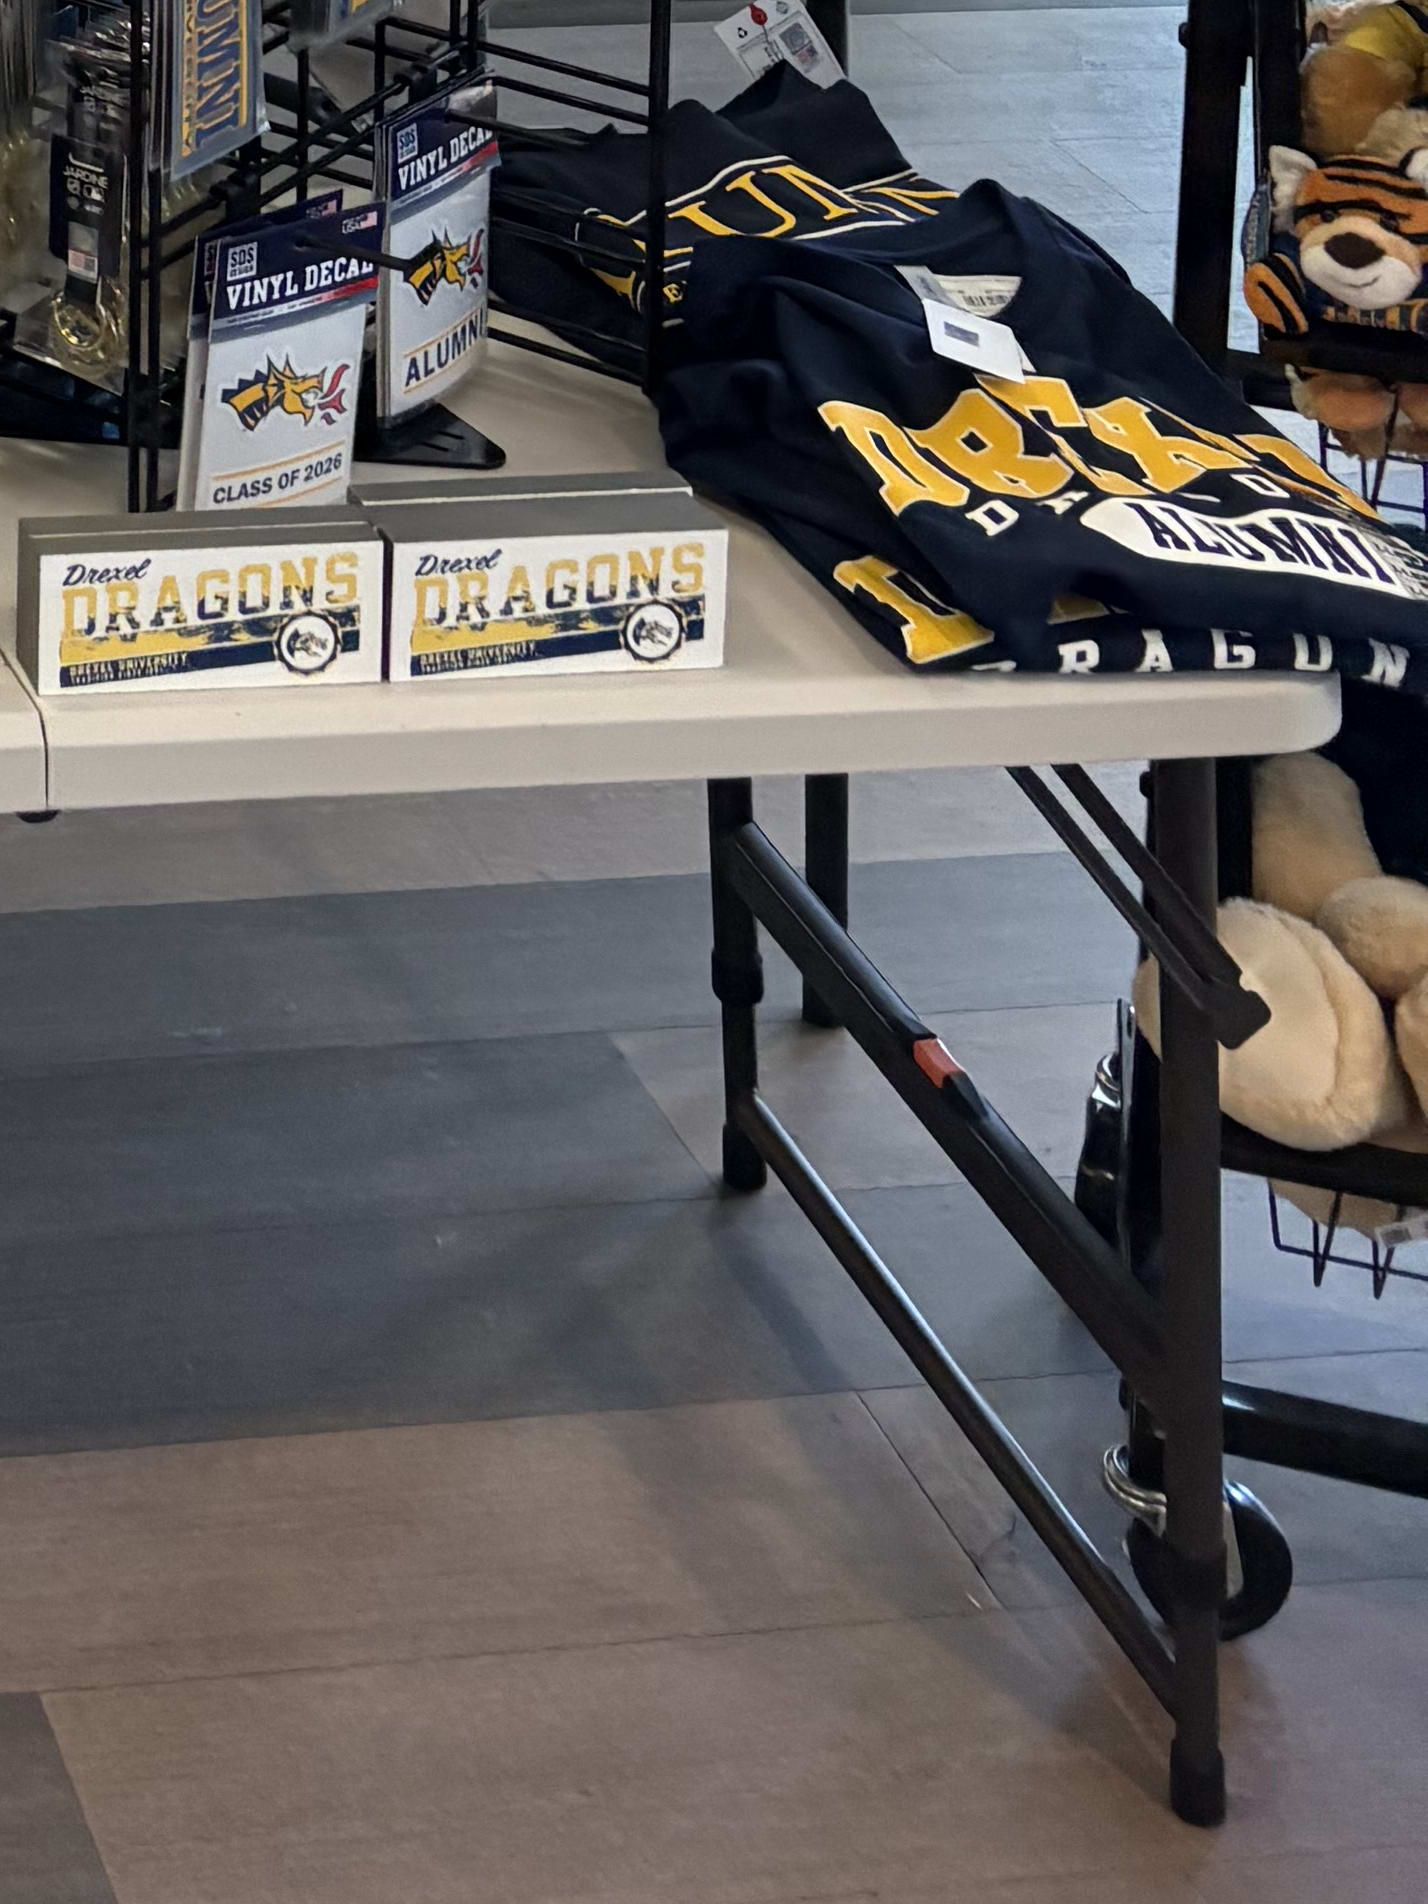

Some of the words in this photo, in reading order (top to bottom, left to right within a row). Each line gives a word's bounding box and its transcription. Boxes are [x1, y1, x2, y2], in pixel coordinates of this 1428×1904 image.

[397, 146, 449, 191] VINYL
[448, 124, 494, 164] DECAL
[226, 271, 299, 311] VINYL
[304, 255, 375, 292] DECAL
[402, 306, 486, 388] ALUMNI
[212, 477, 273, 505] CLASS
[277, 468, 301, 491] OF
[303, 452, 343, 483] 2026
[413, 549, 503, 579] Drexel
[1135, 496, 1381, 581] ALUMNI
[61, 551, 360, 639] DRAGONS
[62, 558, 153, 587] Drexel
[410, 542, 706, 628] DRAGONS
